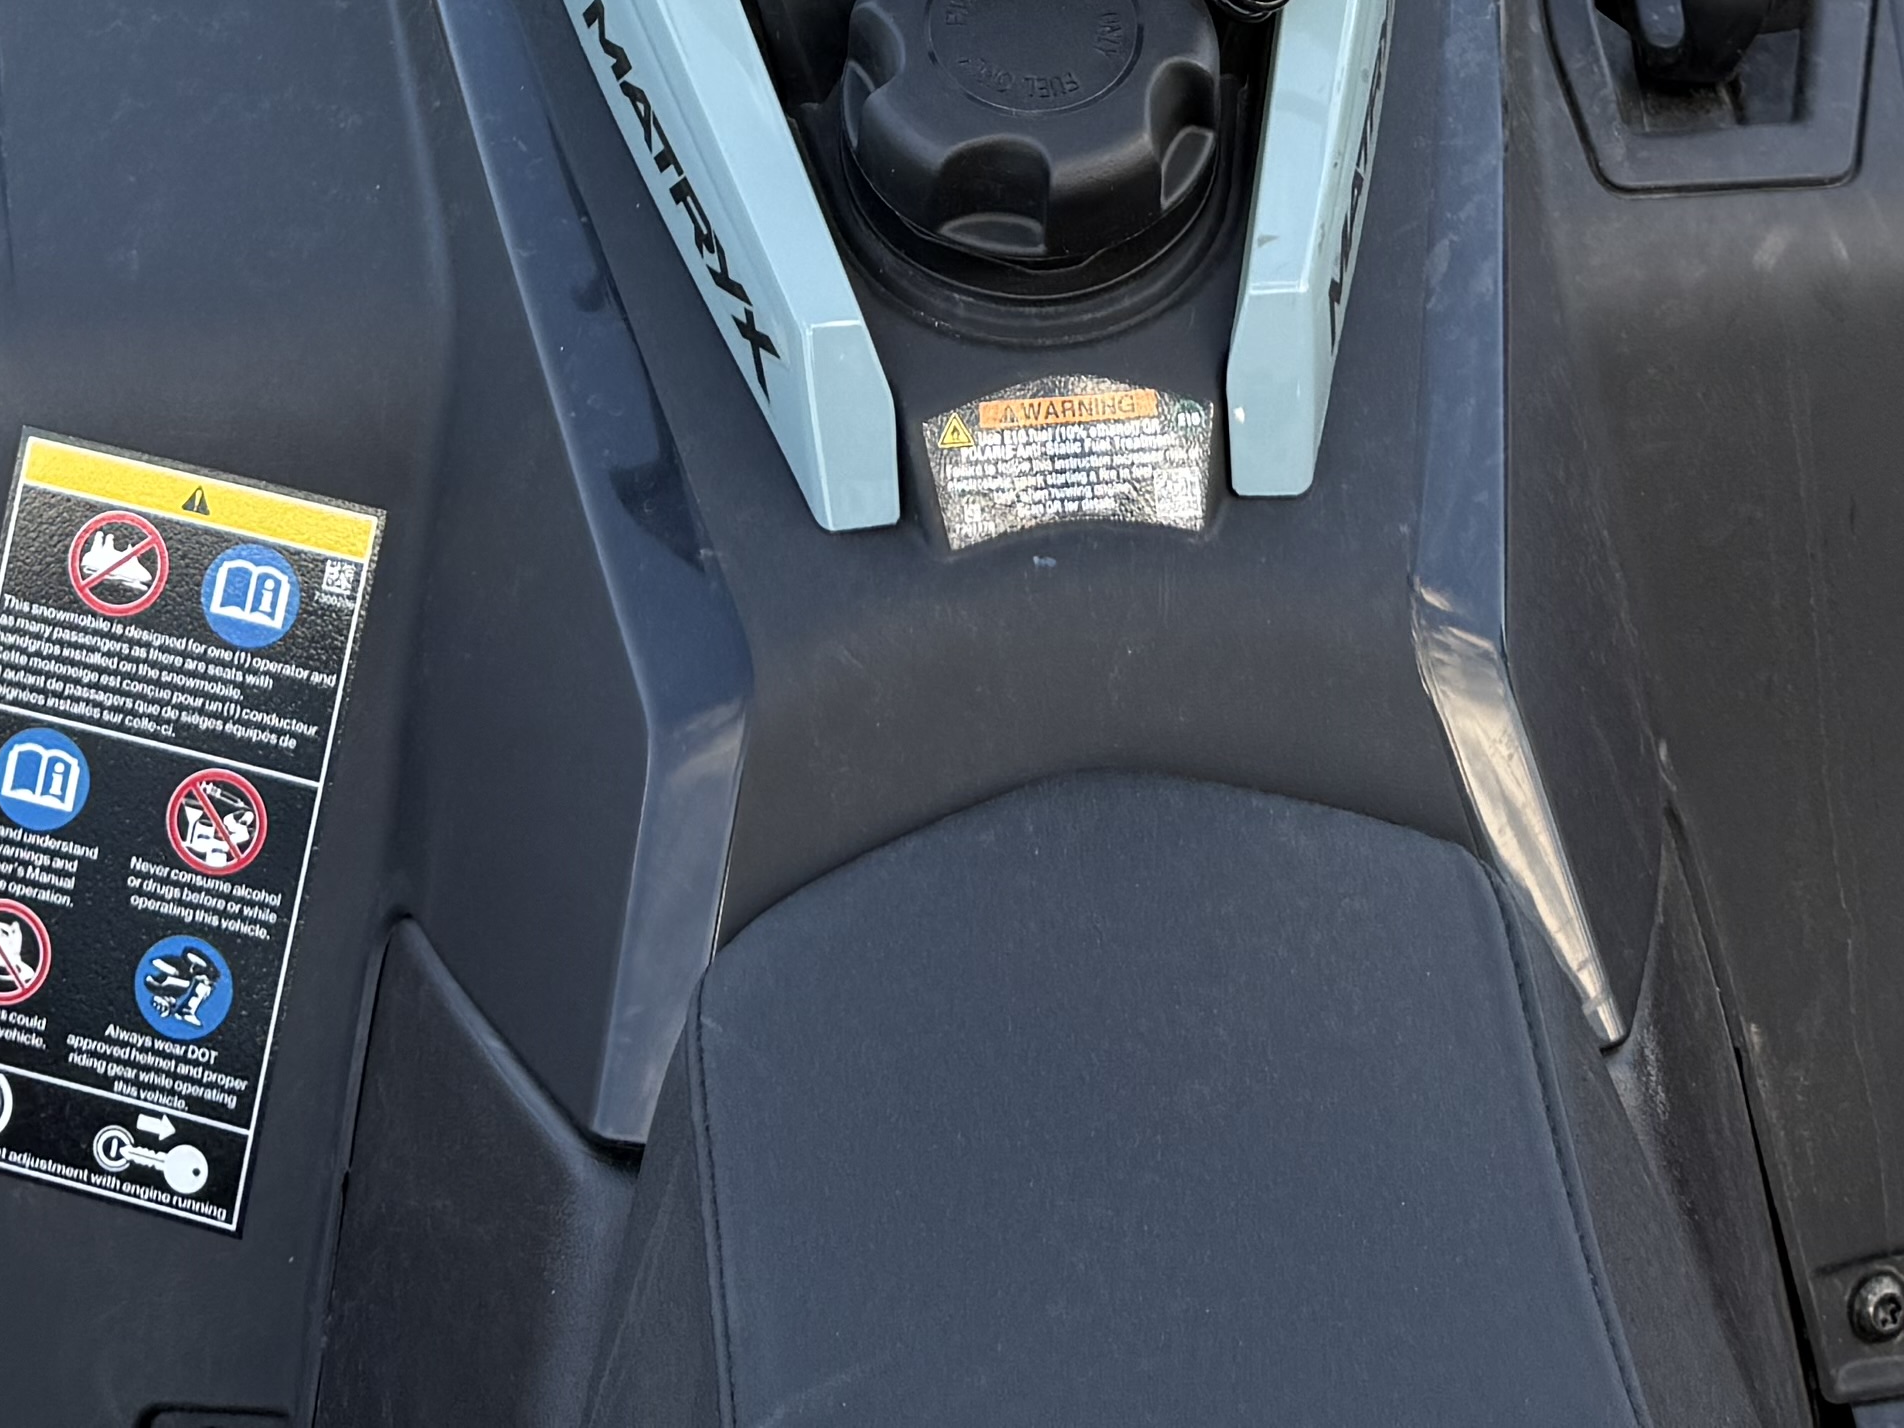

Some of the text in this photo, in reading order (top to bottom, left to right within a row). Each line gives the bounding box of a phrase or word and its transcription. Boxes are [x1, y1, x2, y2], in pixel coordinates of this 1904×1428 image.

[1023, 395, 1136, 422] WARNING
[2, 593, 337, 687] This snowmobile is designed for one (1) operator and
[15, 618, 52, 639] many
[51, 627, 130, 655] passengers
[130, 645, 148, 659] as
[147, 646, 183, 668] there
[183, 658, 206, 673] are
[206, 664, 244, 682] seats
[243, 673, 274, 690] with
[61, 644, 118, 669] installed
[118, 661, 137, 674] on
[137, 662, 160, 680] the
[160, 671, 243, 700] snowmobile.
[2, 668, 46, 687] autant
[45, 676, 64, 692] de
[63, 683, 133, 709] passagers
[133, 700, 160, 715] que
[160, 704, 179, 720] de
[278, 732, 297, 749] de
[99, 674, 122, 688] est
[171, 692, 206, 709] pour
[205, 700, 223, 713] un
[222, 701, 241, 720] (1)
[241, 708, 317, 736] conducteur
[101, 710, 123, 724] sur
[22, 832, 99, 860] understand
[51, 857, 78, 872] and
[7, 881, 73, 907] operation.
[25, 865, 75, 890] Manual
[126, 876, 277, 923] or drugs before or while
[129, 855, 282, 906] Never consume alcohol
[129, 895, 270, 939] operating this vehicle.
[7, 1012, 47, 1030] could
[104, 1022, 218, 1064] Always wear DOT
[65, 1034, 248, 1090] approved helmet and proper
[67, 1050, 237, 1109] riding gear while operating
[112, 1079, 188, 1111] this vehicle.
[7, 1150, 89, 1182] adjustment
[88, 1173, 121, 1191] with
[119, 1181, 172, 1205] engine
[171, 1196, 227, 1222] running
